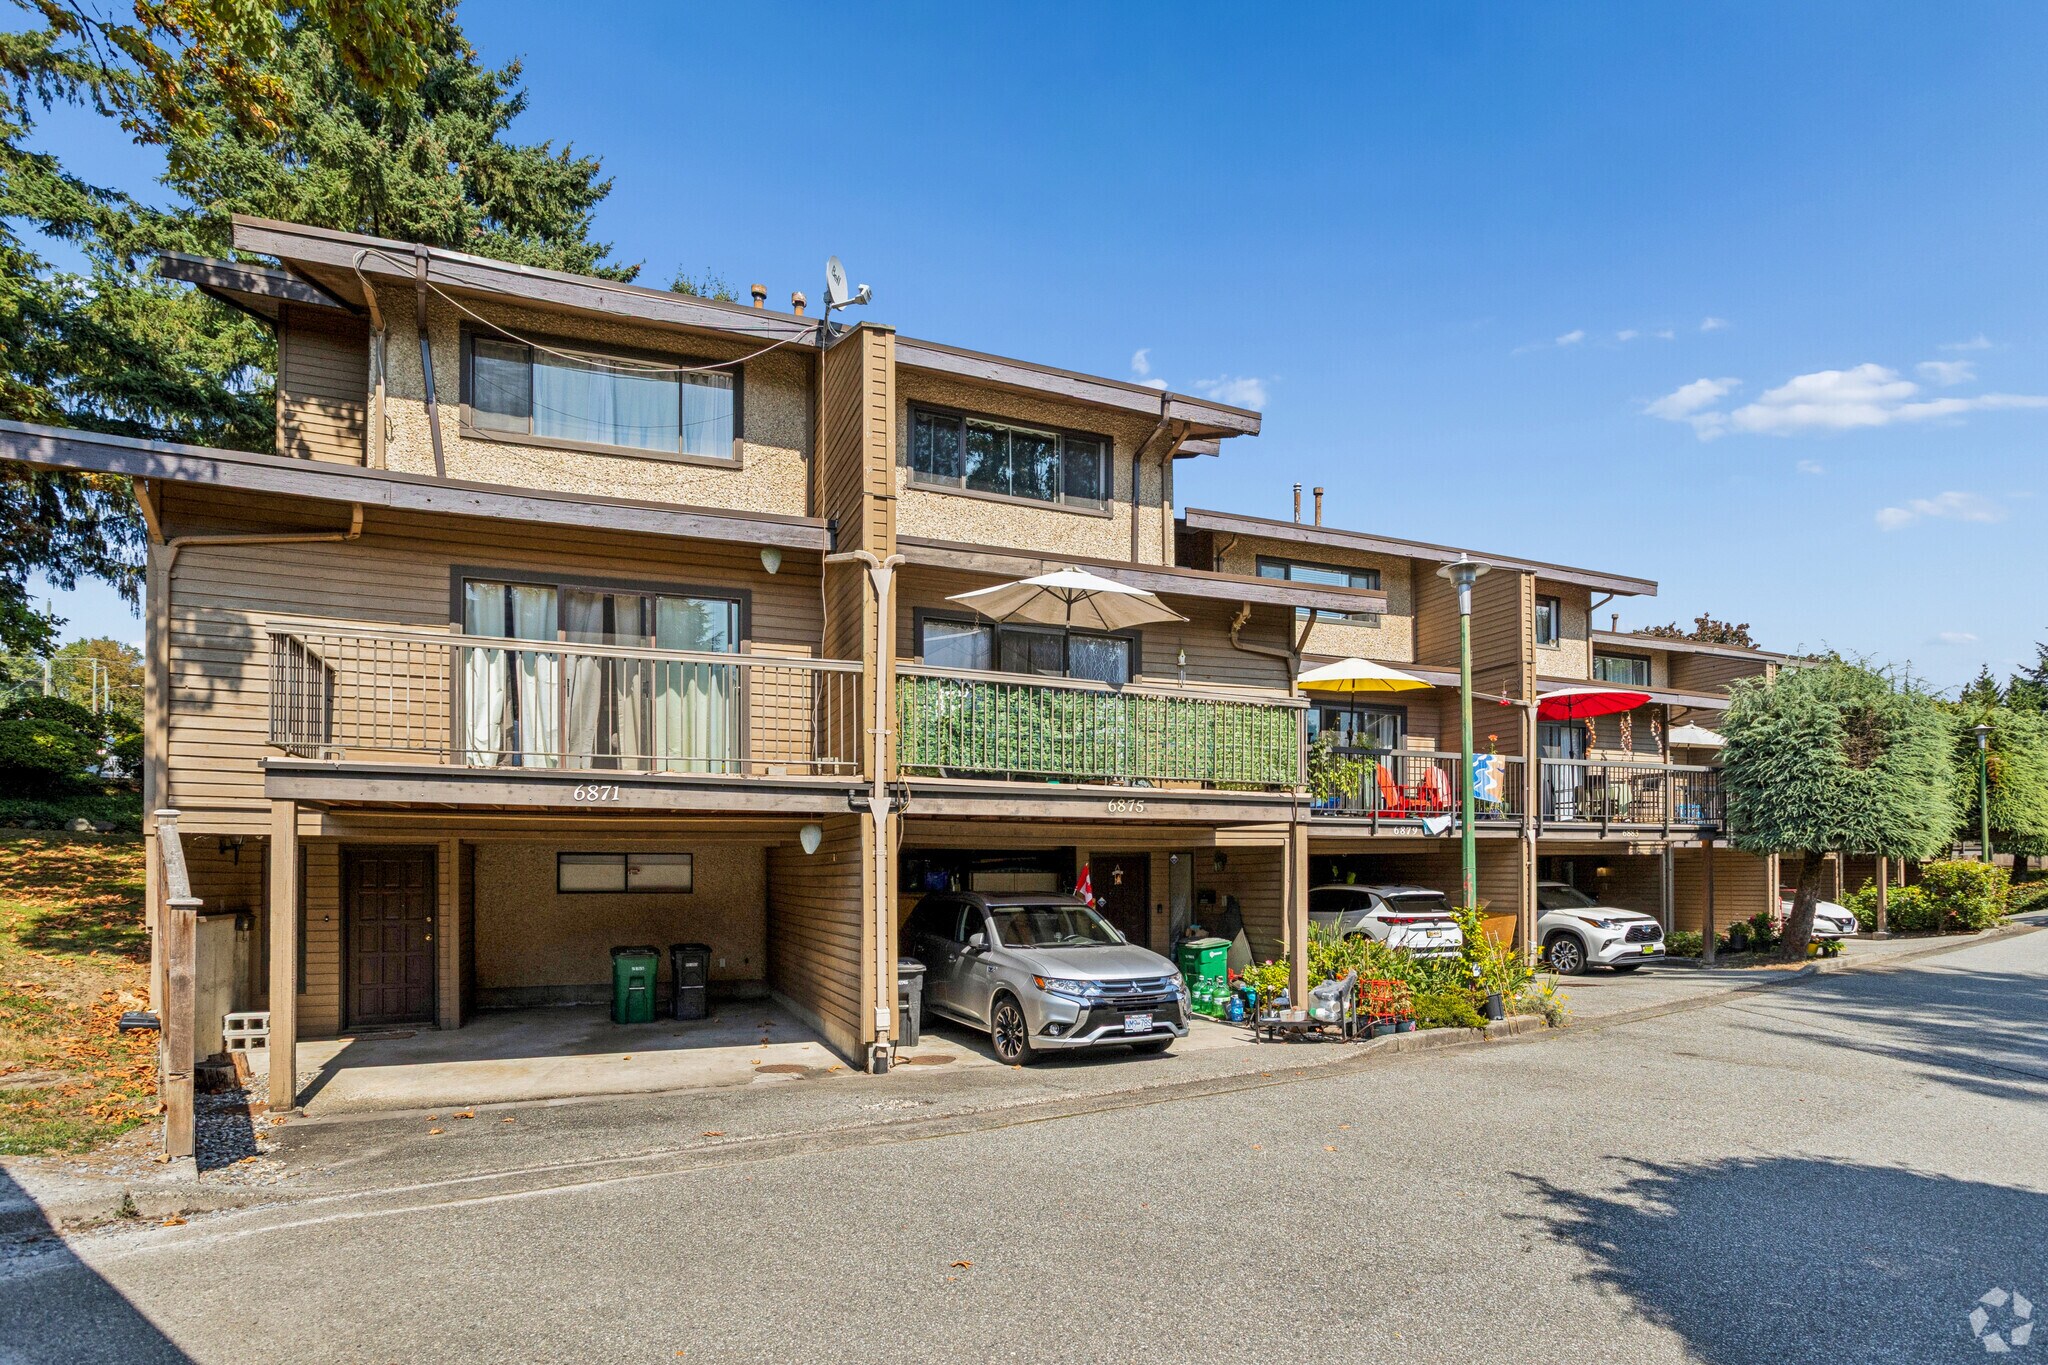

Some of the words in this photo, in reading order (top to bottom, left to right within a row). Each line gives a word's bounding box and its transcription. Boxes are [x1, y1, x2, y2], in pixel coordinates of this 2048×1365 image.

[573, 784, 620, 801] 6871
[1108, 798, 1145, 813] 6875
[1393, 826, 1418, 835] 6879
